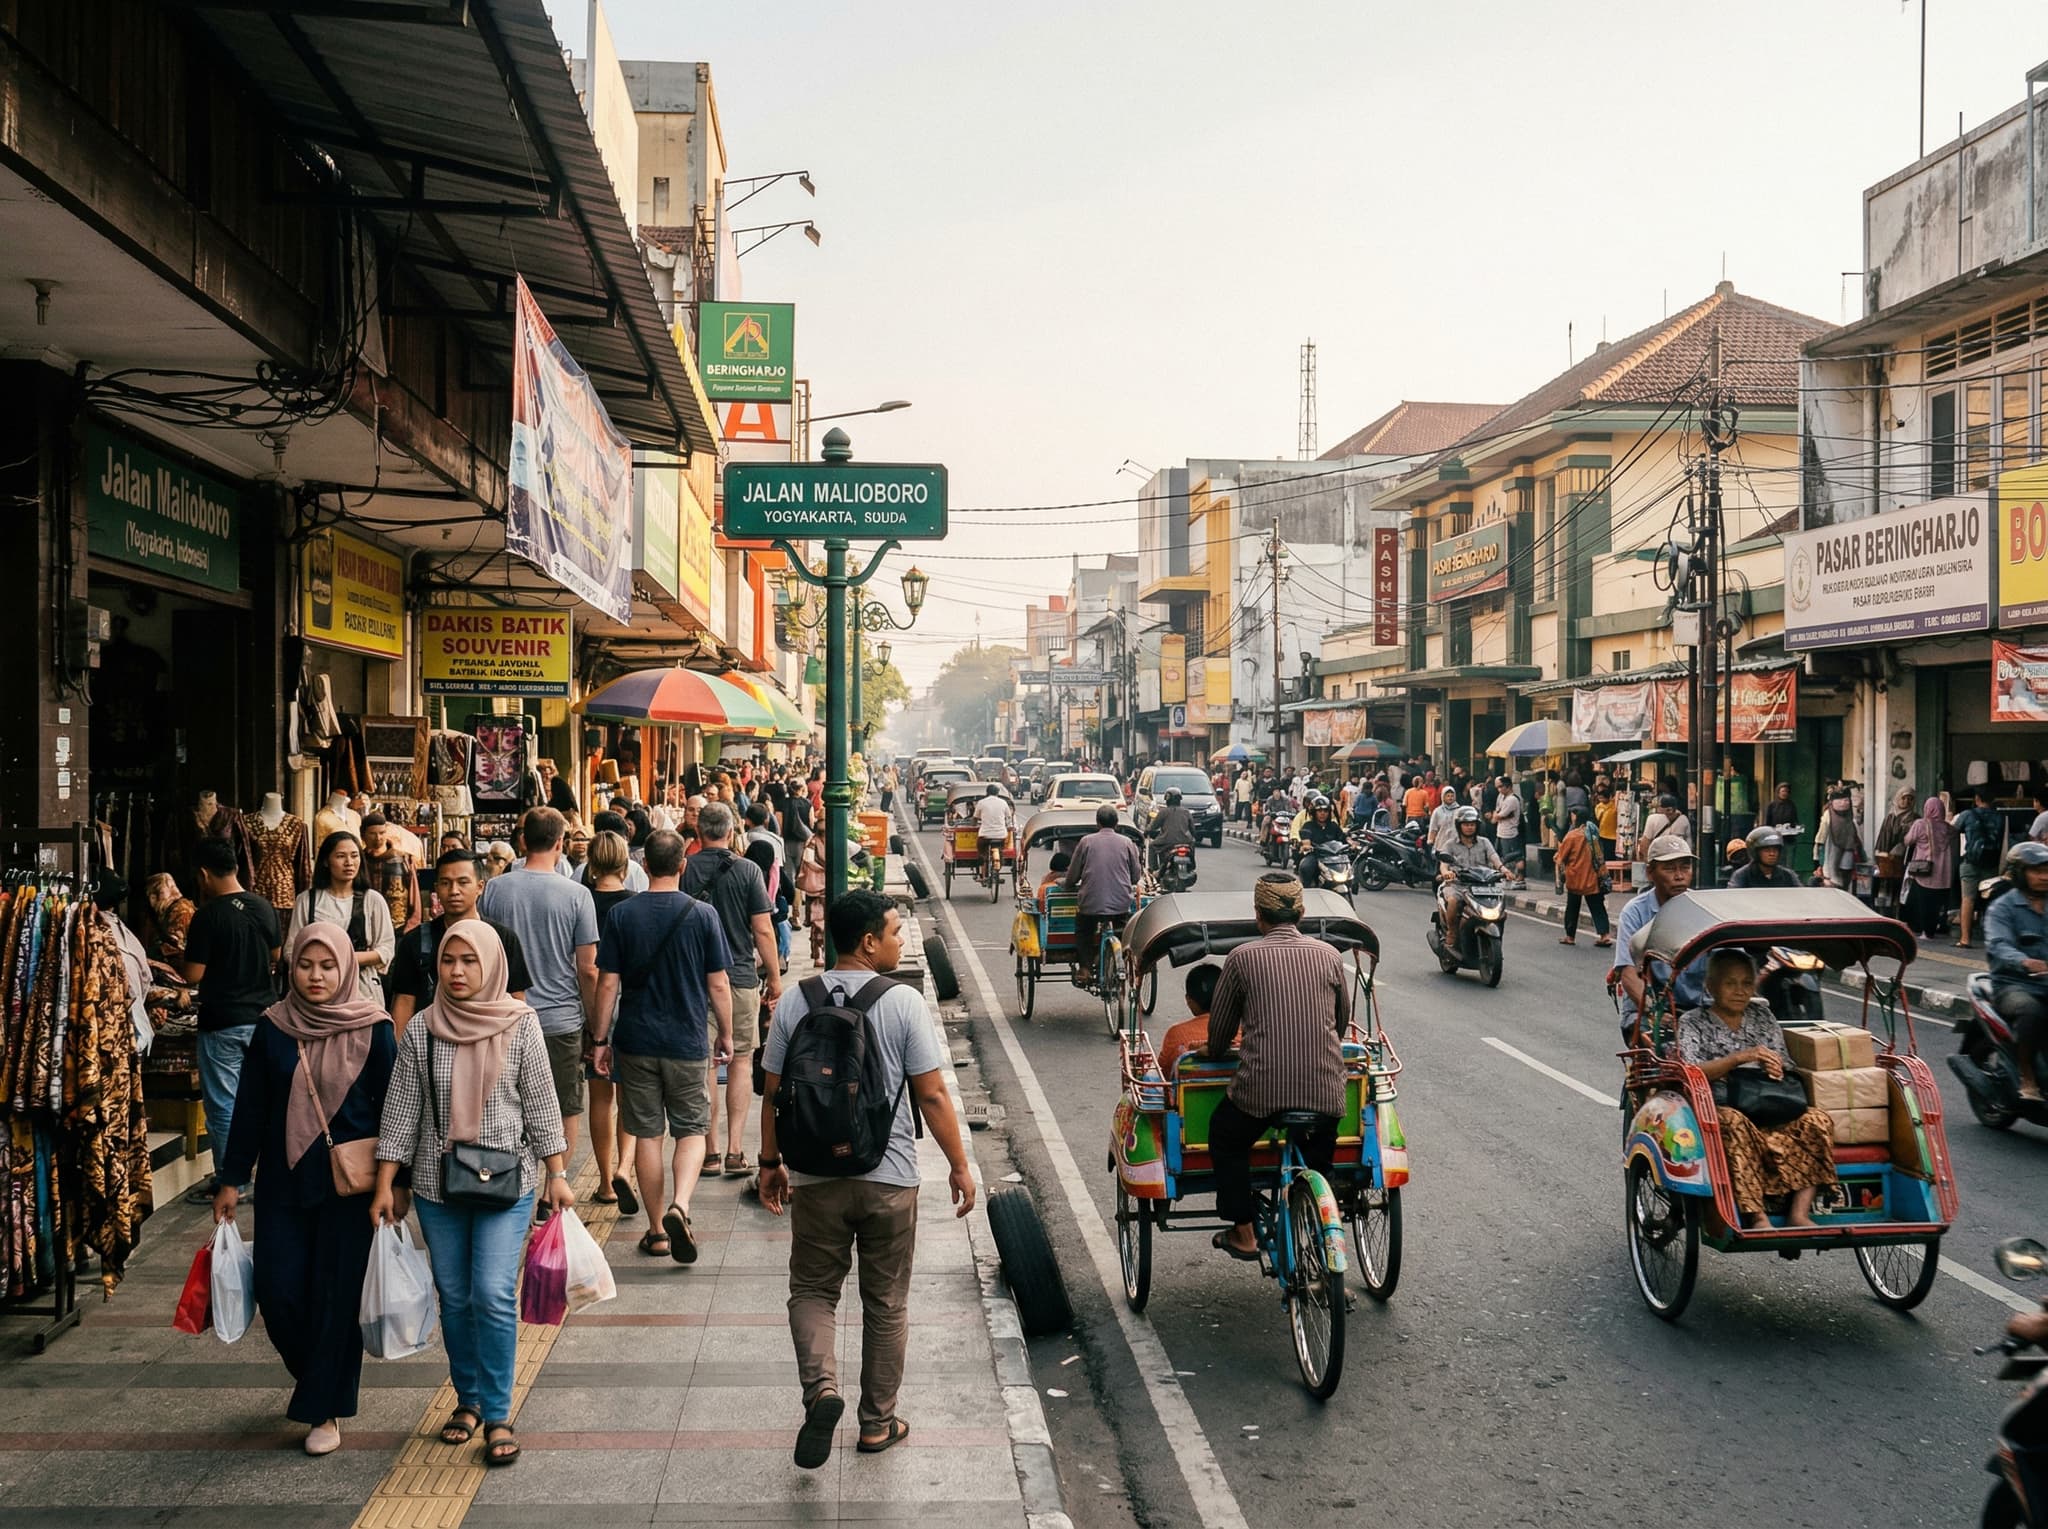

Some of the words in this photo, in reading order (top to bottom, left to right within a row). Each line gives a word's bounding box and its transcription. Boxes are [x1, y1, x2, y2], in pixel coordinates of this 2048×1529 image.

[102, 446, 150, 511] Jalan
[157, 467, 230, 539] Malioboro
[743, 483, 803, 503] JALAN
[814, 483, 928, 504] MALIOBORO
[764, 511, 856, 525] YOGYAKARTA,
[1817, 534, 1860, 576] PASAR
[1865, 507, 1980, 566] BERINGHARJO
[428, 615, 493, 632] DAKIS
[502, 617, 565, 635] BATIK
[442, 638, 551, 656] SOUVENIR
